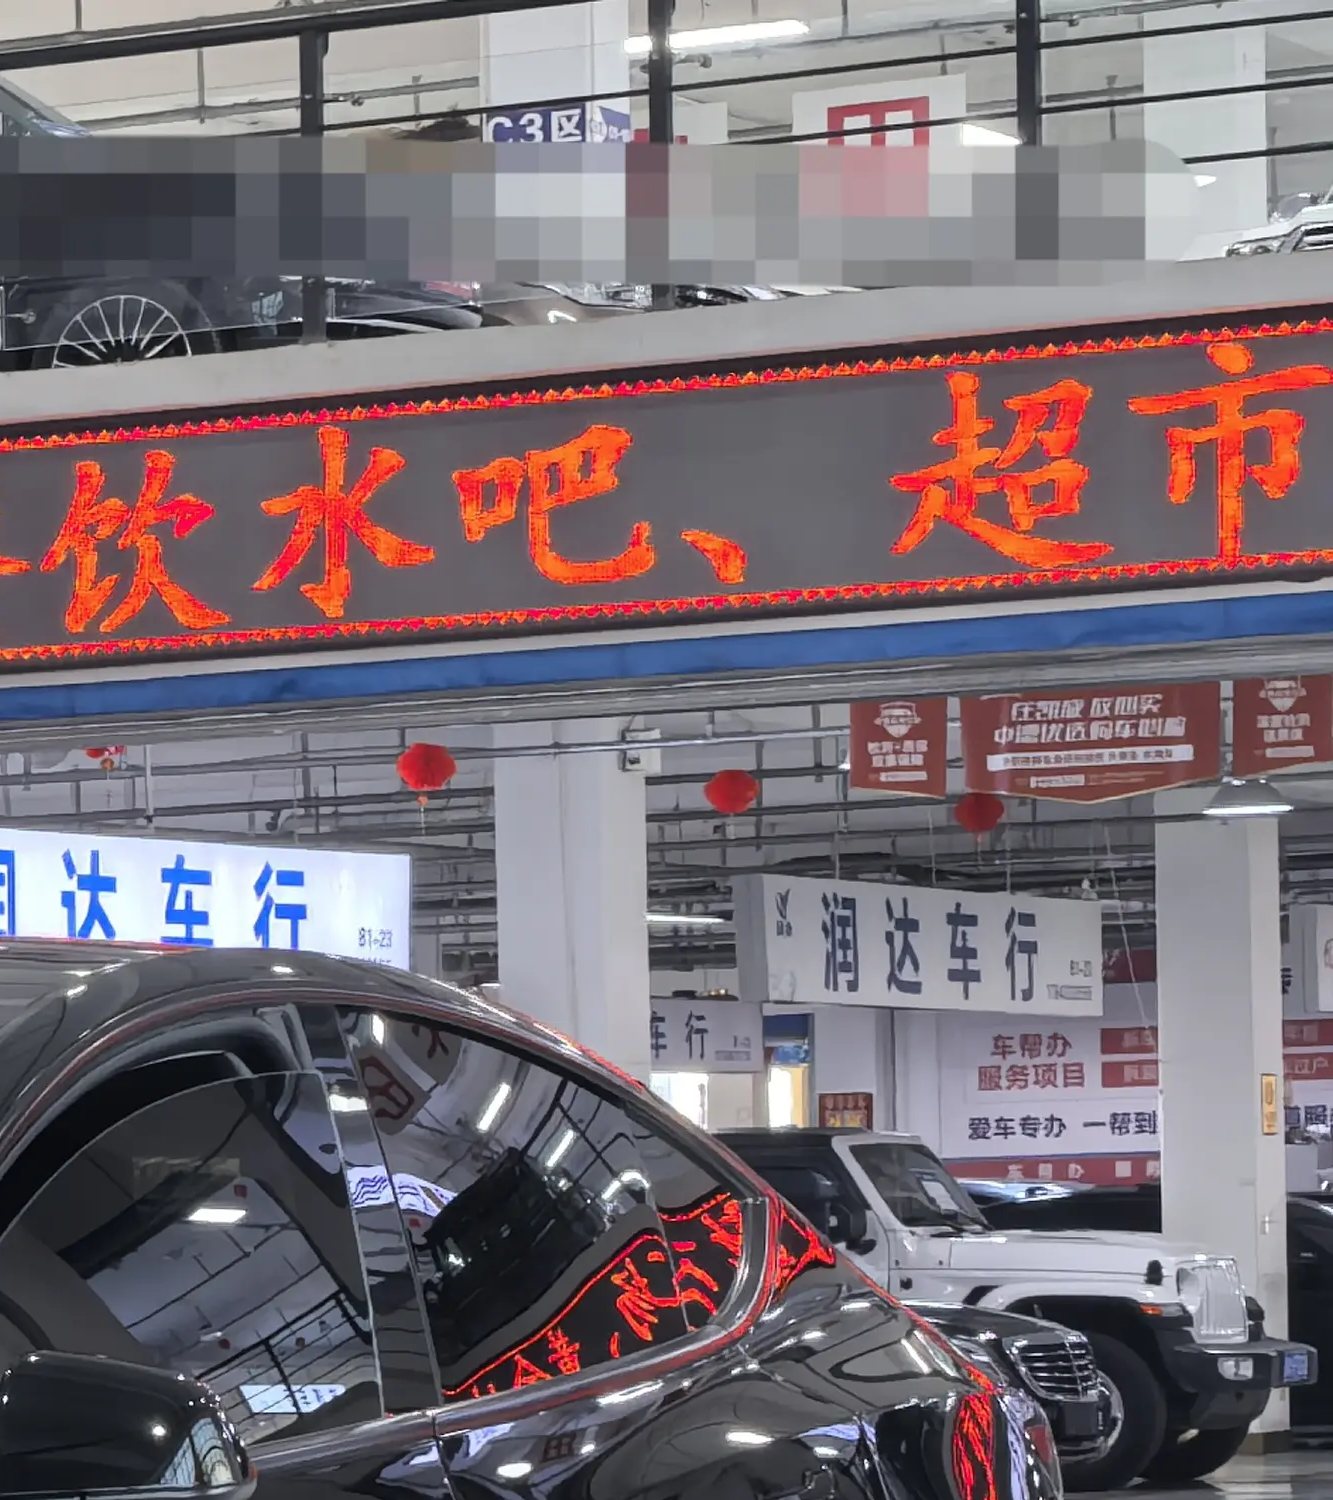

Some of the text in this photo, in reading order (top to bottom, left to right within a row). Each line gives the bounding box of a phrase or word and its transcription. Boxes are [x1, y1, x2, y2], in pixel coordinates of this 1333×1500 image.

[821, 890, 1039, 1003] 润达车行
[991, 1032, 1073, 1060] 车帮办
[977, 1062, 1086, 1092] 服务项目
[968, 1113, 1067, 1141] 爱车专办
